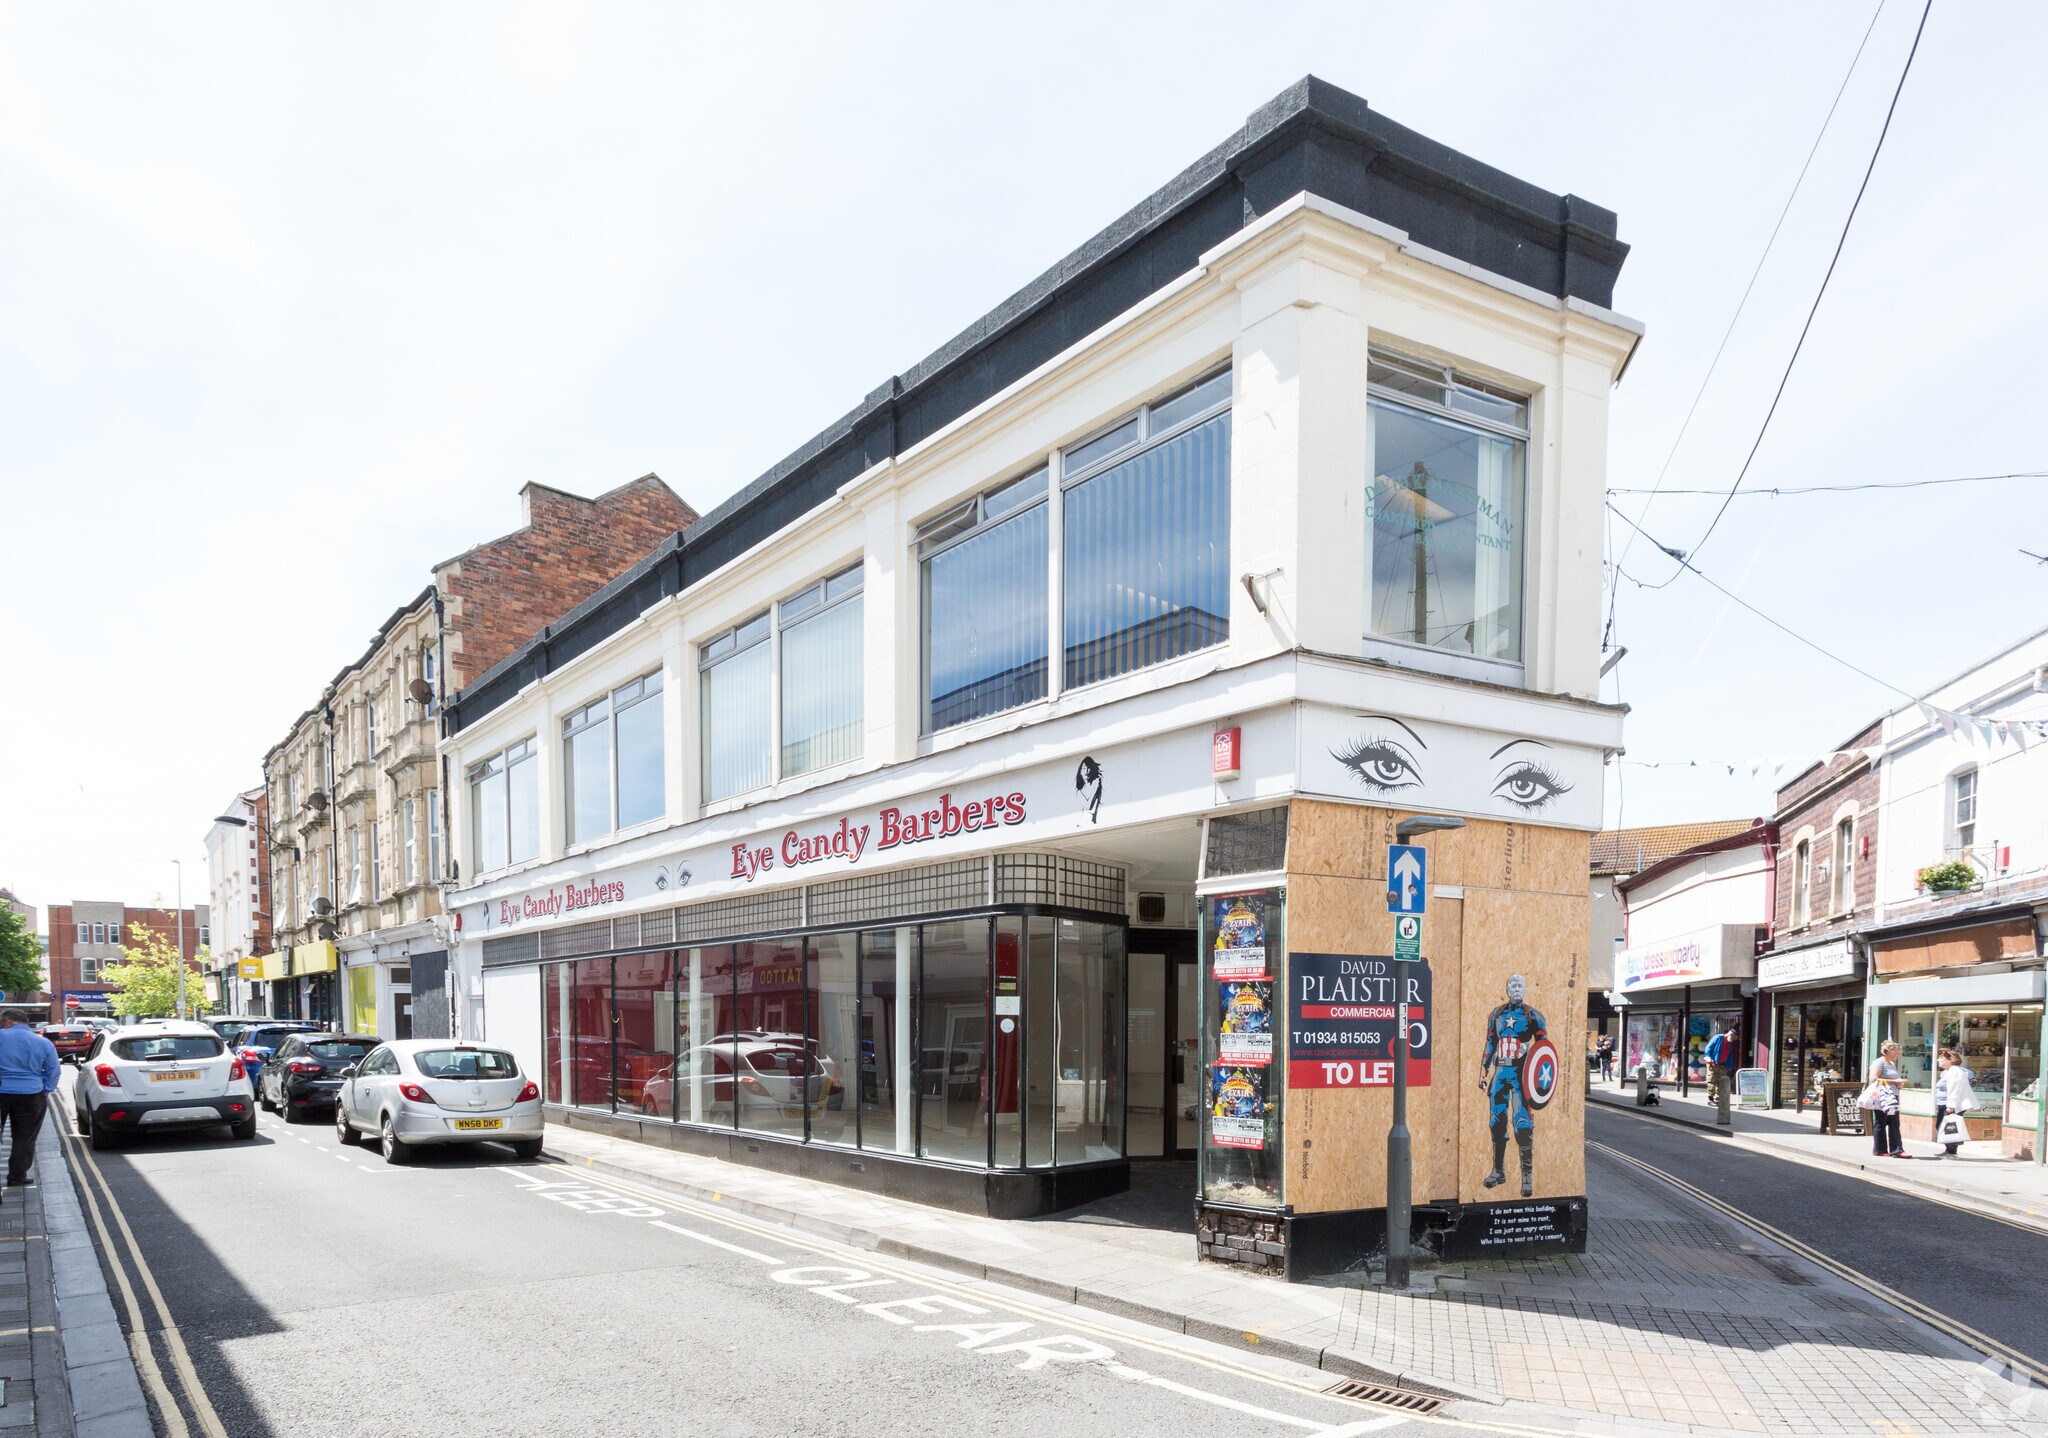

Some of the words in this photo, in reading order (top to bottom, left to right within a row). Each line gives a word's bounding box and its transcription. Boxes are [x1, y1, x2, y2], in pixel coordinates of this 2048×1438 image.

[730, 842, 773, 881] Eye
[781, 817, 870, 863] Candy
[877, 791, 1027, 850] Barbers
[500, 899, 521, 927] Eye
[523, 888, 563, 920] Candy
[565, 878, 625, 911] Barbers
[1815, 949, 1845, 970] Active
[1341, 961, 1386, 975] DAVID
[1301, 976, 1424, 1003] PLAISTR
[1293, 1032, 1301, 1044] T
[1304, 1032, 1337, 1044] 01934
[1340, 1032, 1381, 1044] 815053
[1293, 1047, 1380, 1058] www.davidplaister.co.uk
[1322, 1062, 1354, 1085] TO
[1837, 1097, 1857, 1106] OLD
[1836, 1105, 1861, 1114] GUYS
[458, 1119, 482, 1128] WN58
[484, 1119, 499, 1127] DKF
[1837, 1113, 1861, 1122] RULE
[515, 1182, 666, 1217] KEEP
[1503, 1227, 1514, 1235] just
[1523, 1226, 1538, 1234] angry
[770, 1266, 1116, 1371] CLEAR
